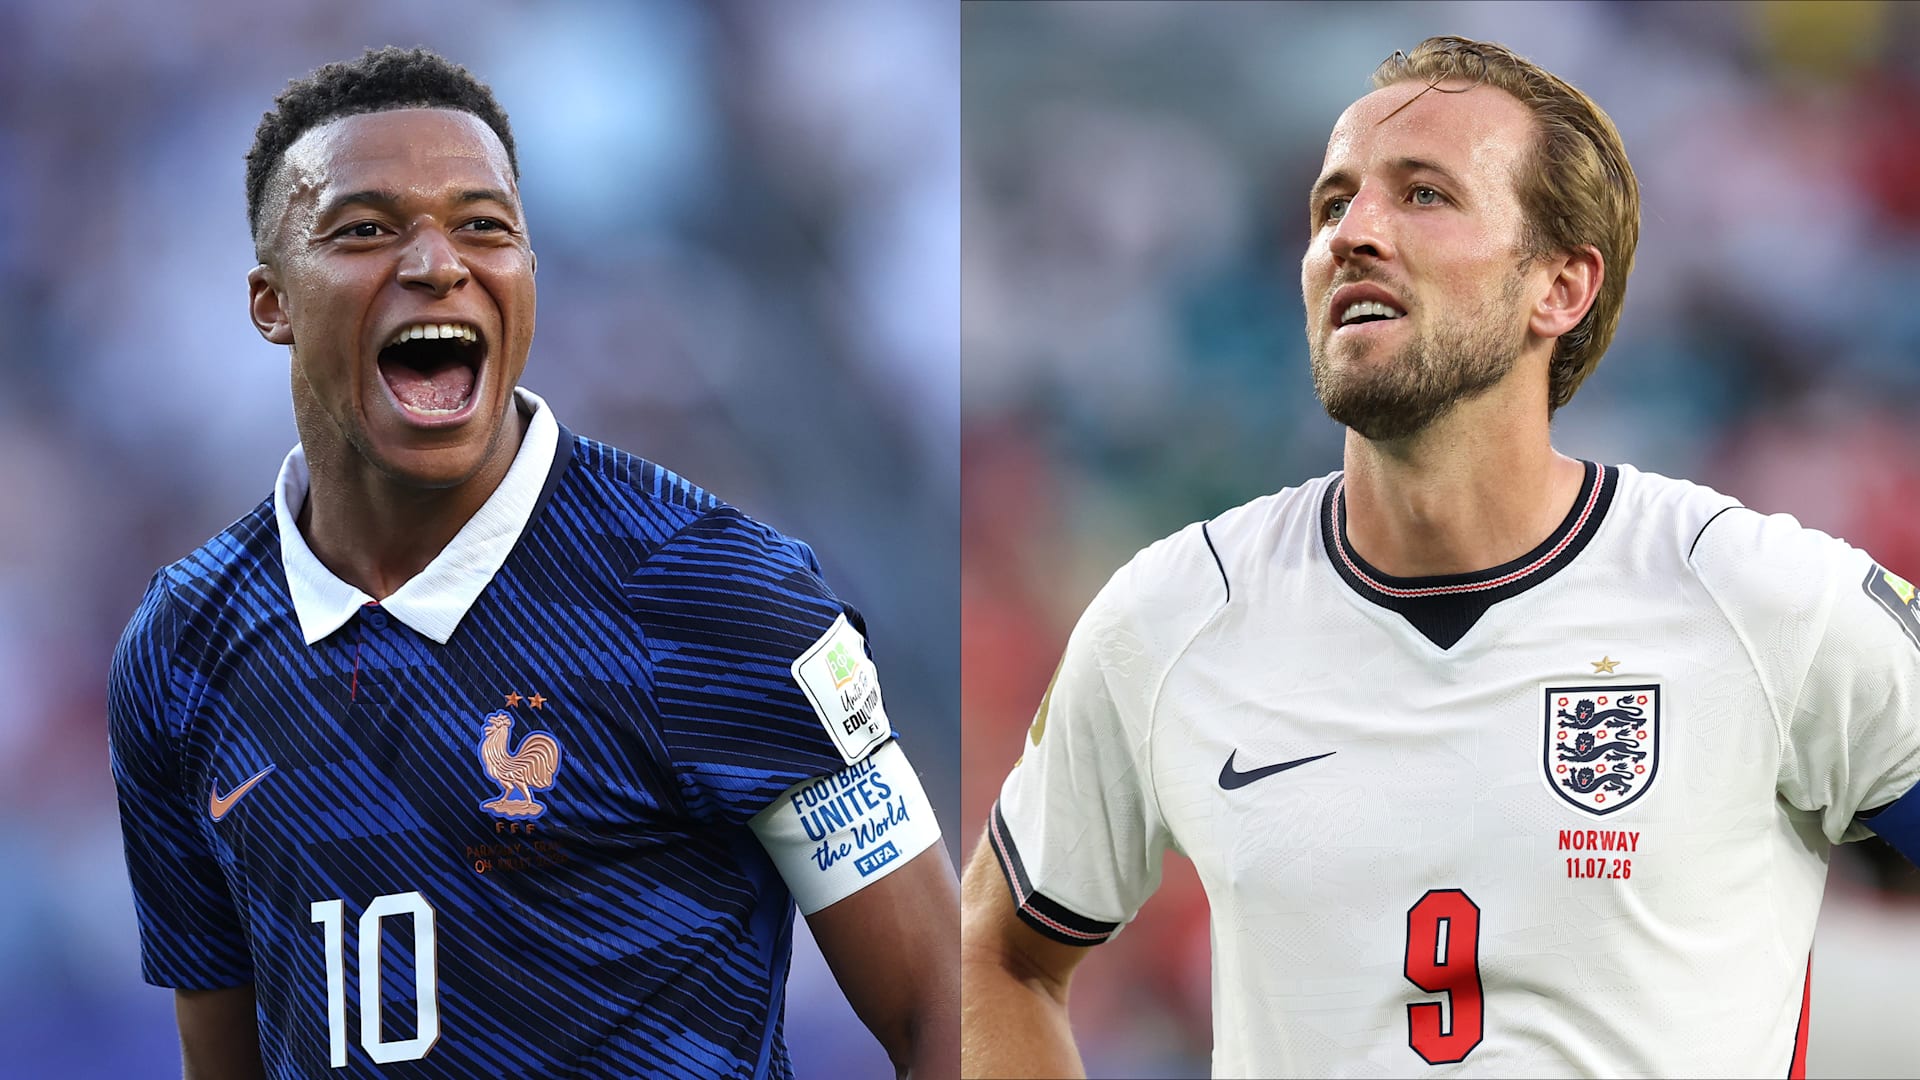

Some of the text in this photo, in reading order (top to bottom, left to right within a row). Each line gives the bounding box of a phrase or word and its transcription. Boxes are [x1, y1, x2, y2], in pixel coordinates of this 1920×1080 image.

[790, 756, 876, 815] FOOTBALL
[800, 771, 892, 842] UNITES
[811, 794, 910, 871] the World
[859, 846, 896, 873] FIFA
[1558, 830, 1640, 852] NORWAY
[1566, 858, 1632, 880] 11.07.26
[311, 891, 441, 1068] 10
[1404, 888, 1484, 1066] 9
